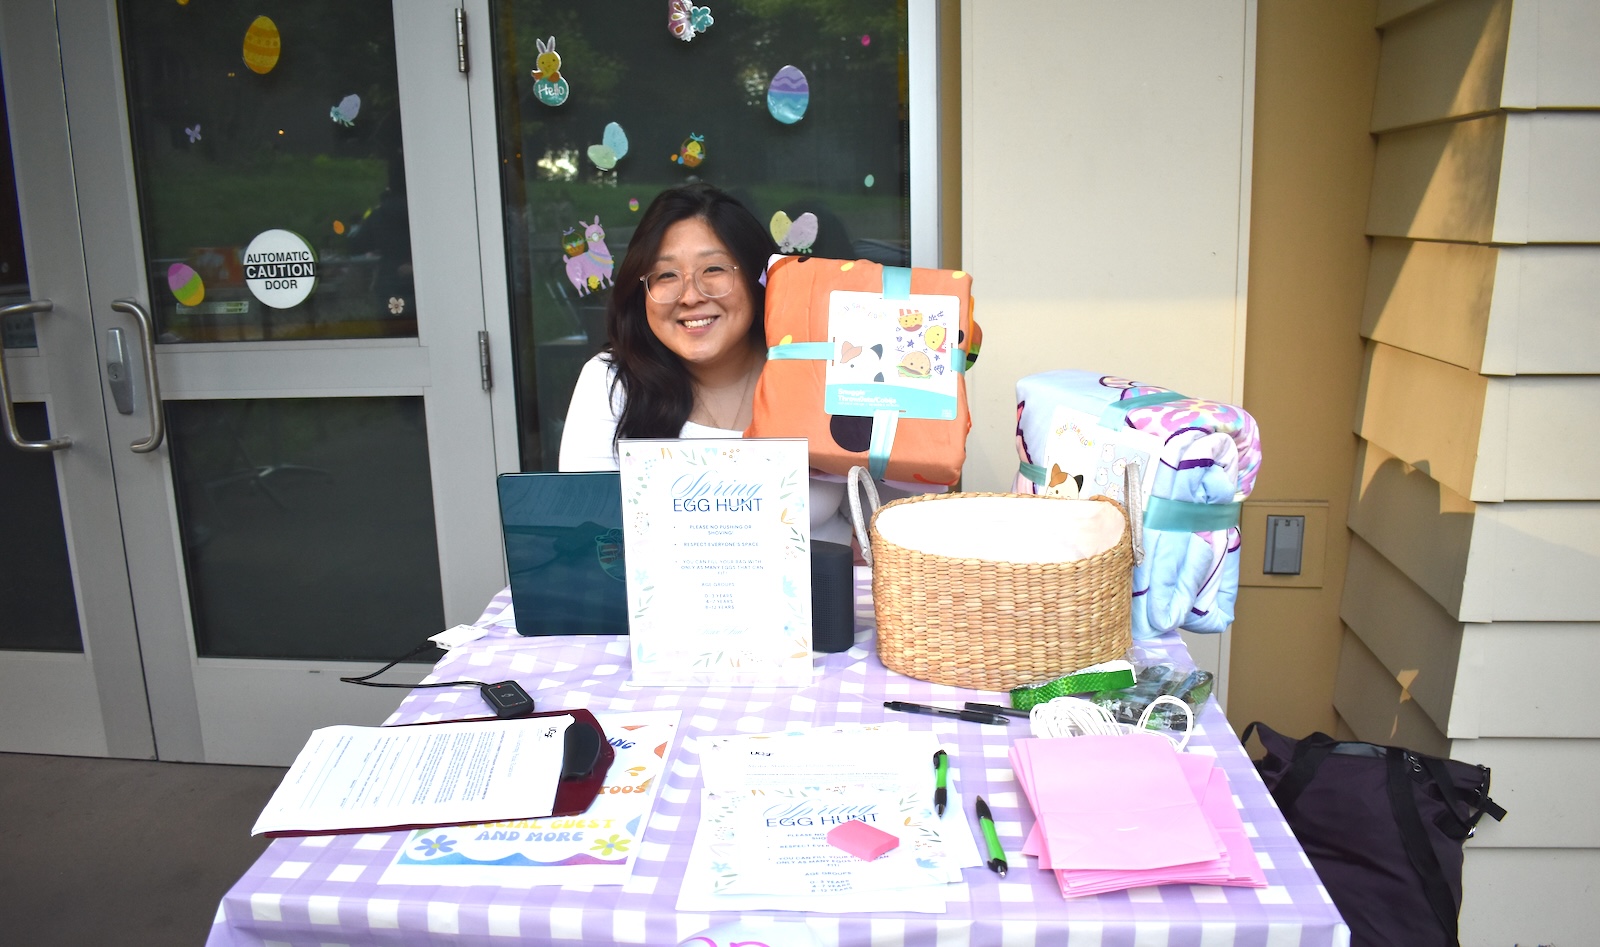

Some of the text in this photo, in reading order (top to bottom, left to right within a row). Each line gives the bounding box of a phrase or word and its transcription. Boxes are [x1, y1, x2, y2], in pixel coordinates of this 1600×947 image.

[538, 83, 565, 99] Hello
[246, 251, 310, 264] AUTOMATIC
[246, 263, 314, 279] CAUTION
[265, 279, 298, 290] DOOR
[670, 469, 763, 508] Spring
[673, 498, 763, 512] EGG HUNT
[607, 737, 636, 750] ING
[597, 785, 646, 795] TOOS
[458, 818, 617, 830] ECIAL GUEST
[766, 813, 879, 827] EGG HUNT
[474, 831, 585, 842] AND MORE
